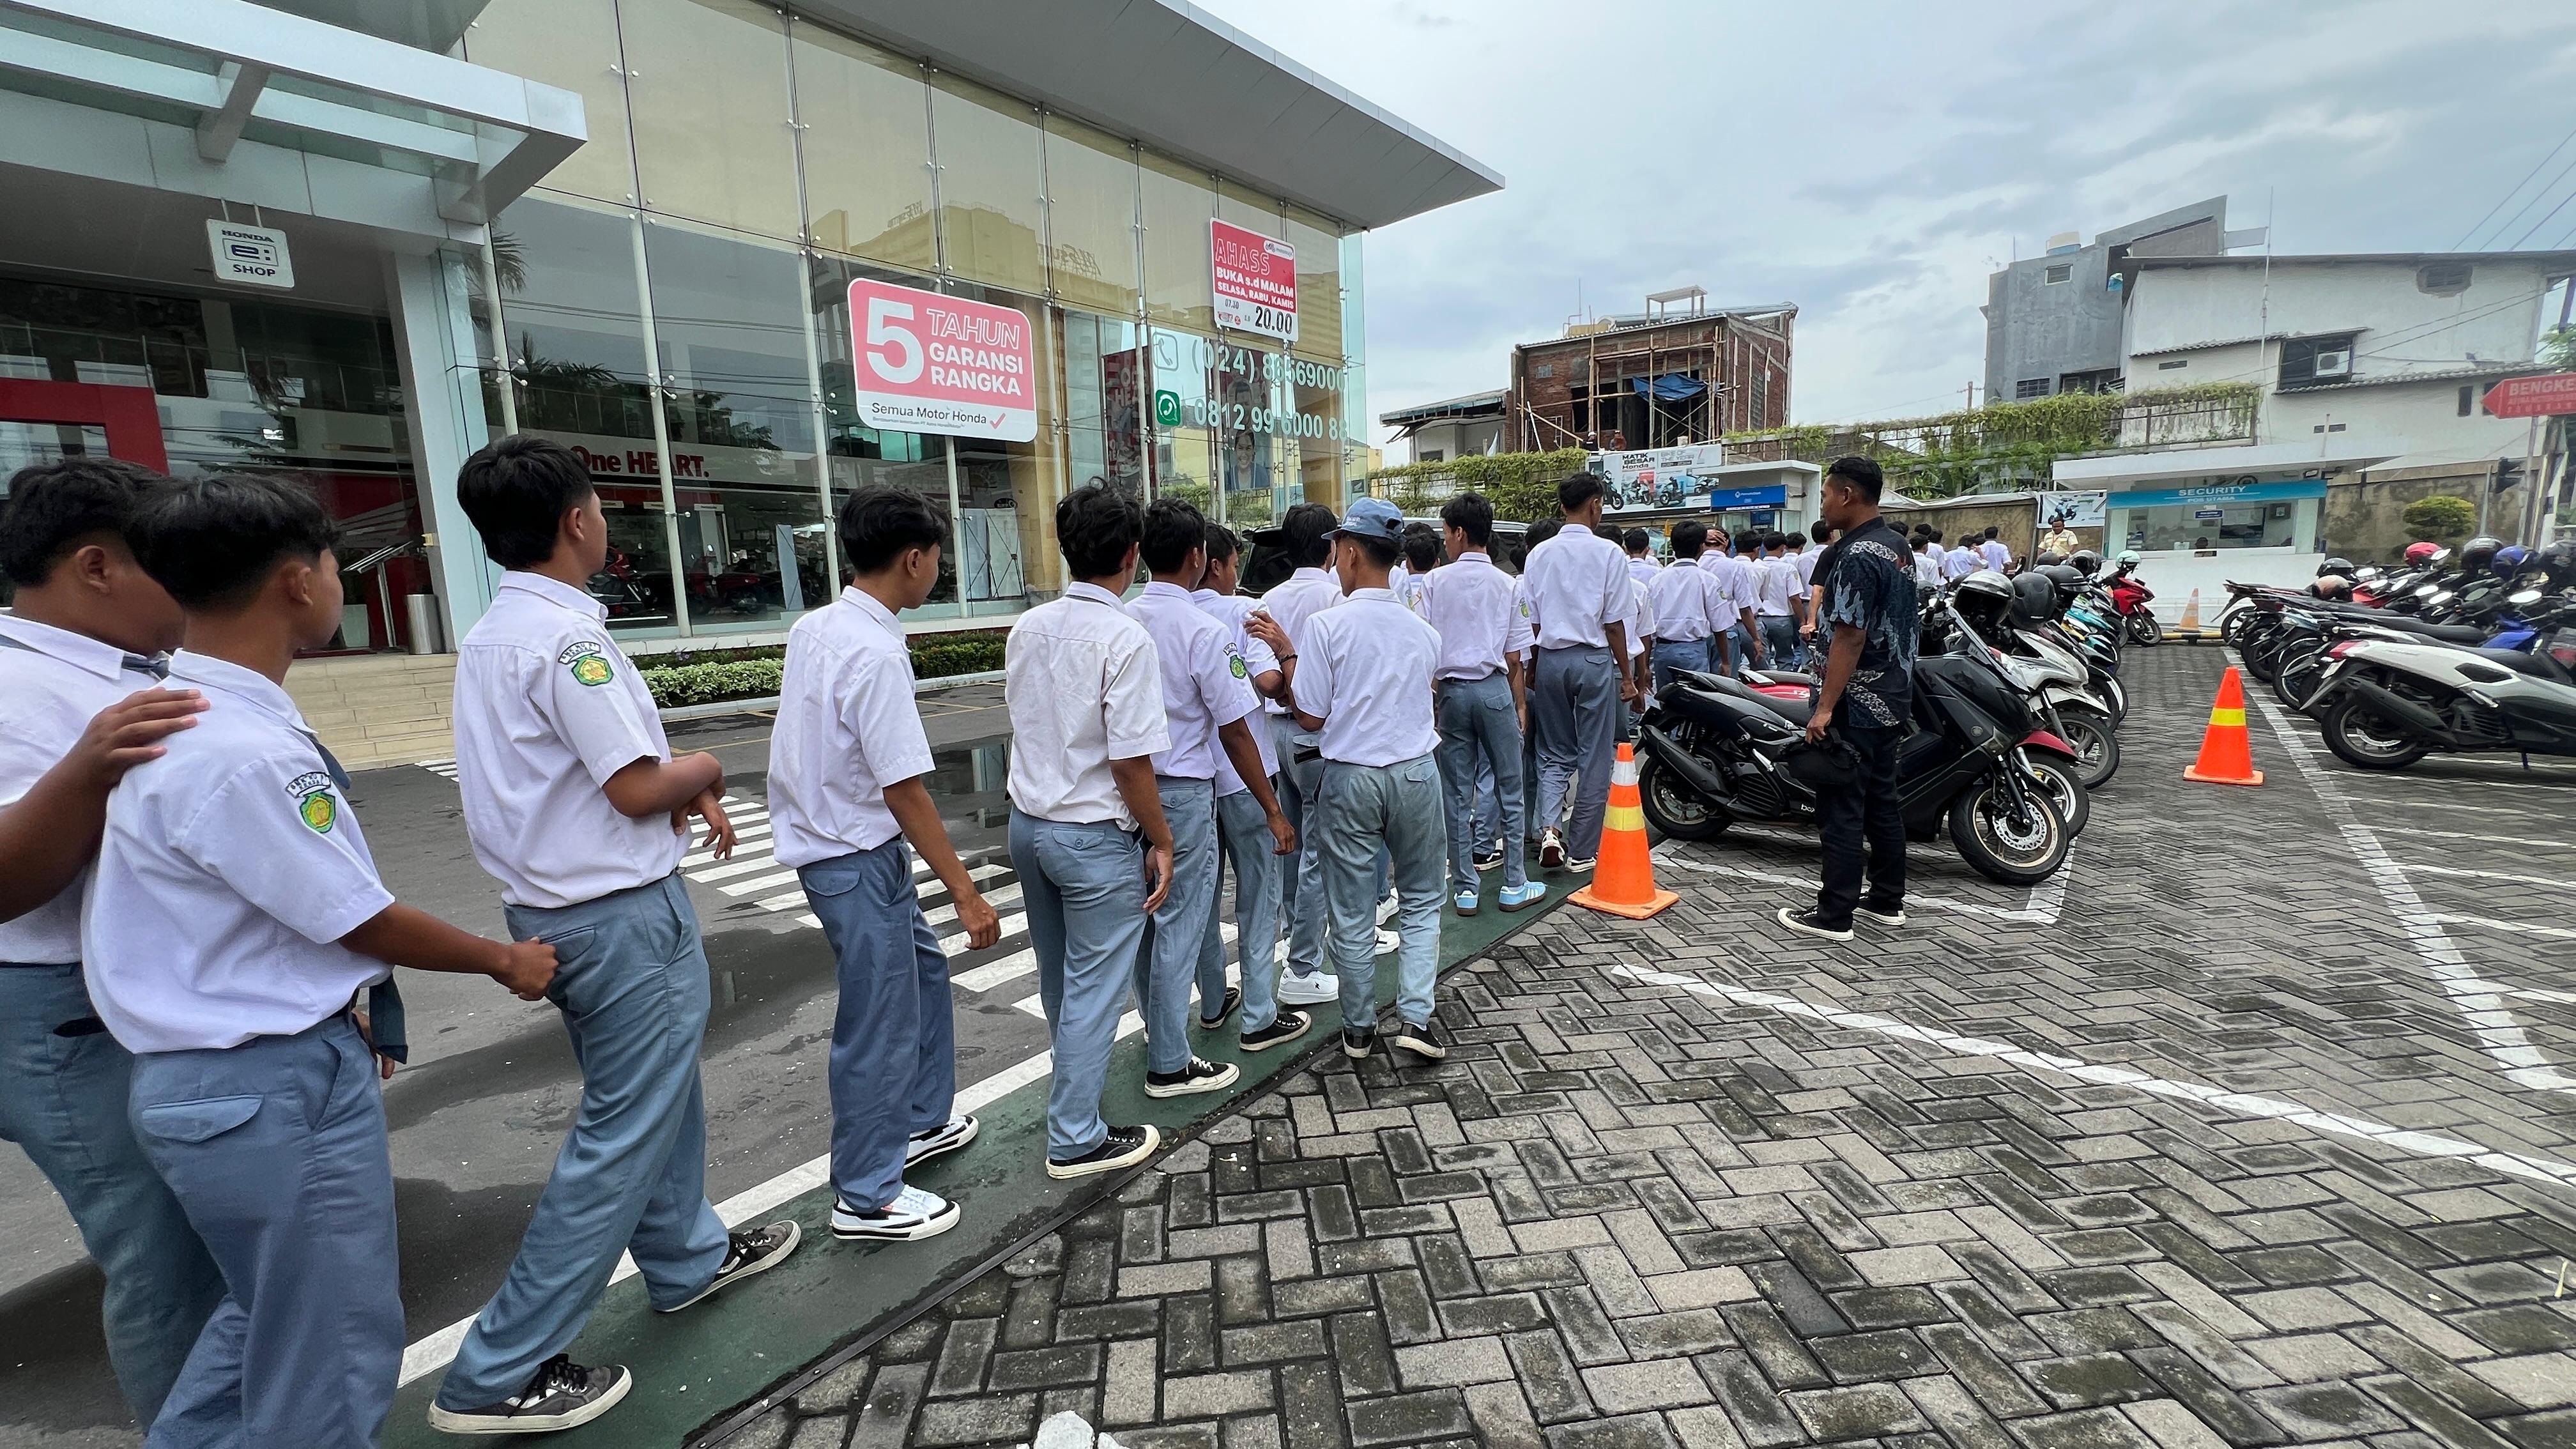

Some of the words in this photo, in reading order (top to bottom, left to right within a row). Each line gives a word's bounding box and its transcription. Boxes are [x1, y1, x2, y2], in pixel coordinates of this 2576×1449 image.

[222, 229, 274, 243] HONDA
[233, 264, 275, 276] SHOP
[1215, 238, 1270, 275] AHASS
[1216, 266, 1244, 285] BUKA
[1261, 279, 1294, 298] MALAM
[1218, 281, 1248, 298] SELASA,
[1248, 289, 1271, 305] RABU,
[1271, 295, 1294, 310] KAMIS
[927, 308, 1020, 349] TAHUN
[1255, 305, 1292, 334] 20.00
[867, 296, 924, 383] 5
[930, 342, 1023, 374] GARANSI
[931, 366, 1022, 396] RANGKA
[2510, 378, 2576, 396] BENGKE
[871, 402, 914, 417] Semua
[917, 407, 950, 420] Motor
[953, 411, 987, 424] Honda
[1194, 399, 1245, 431] 0812
[1251, 406, 1275, 434] 99
[1281, 411, 1323, 439] 6000
[571, 445, 621, 473] One
[627, 450, 710, 478] HERT.
[1622, 452, 1648, 461] MATIK
[1623, 457, 1655, 466] BESAR
[2179, 486, 2246, 496] SECURITY
